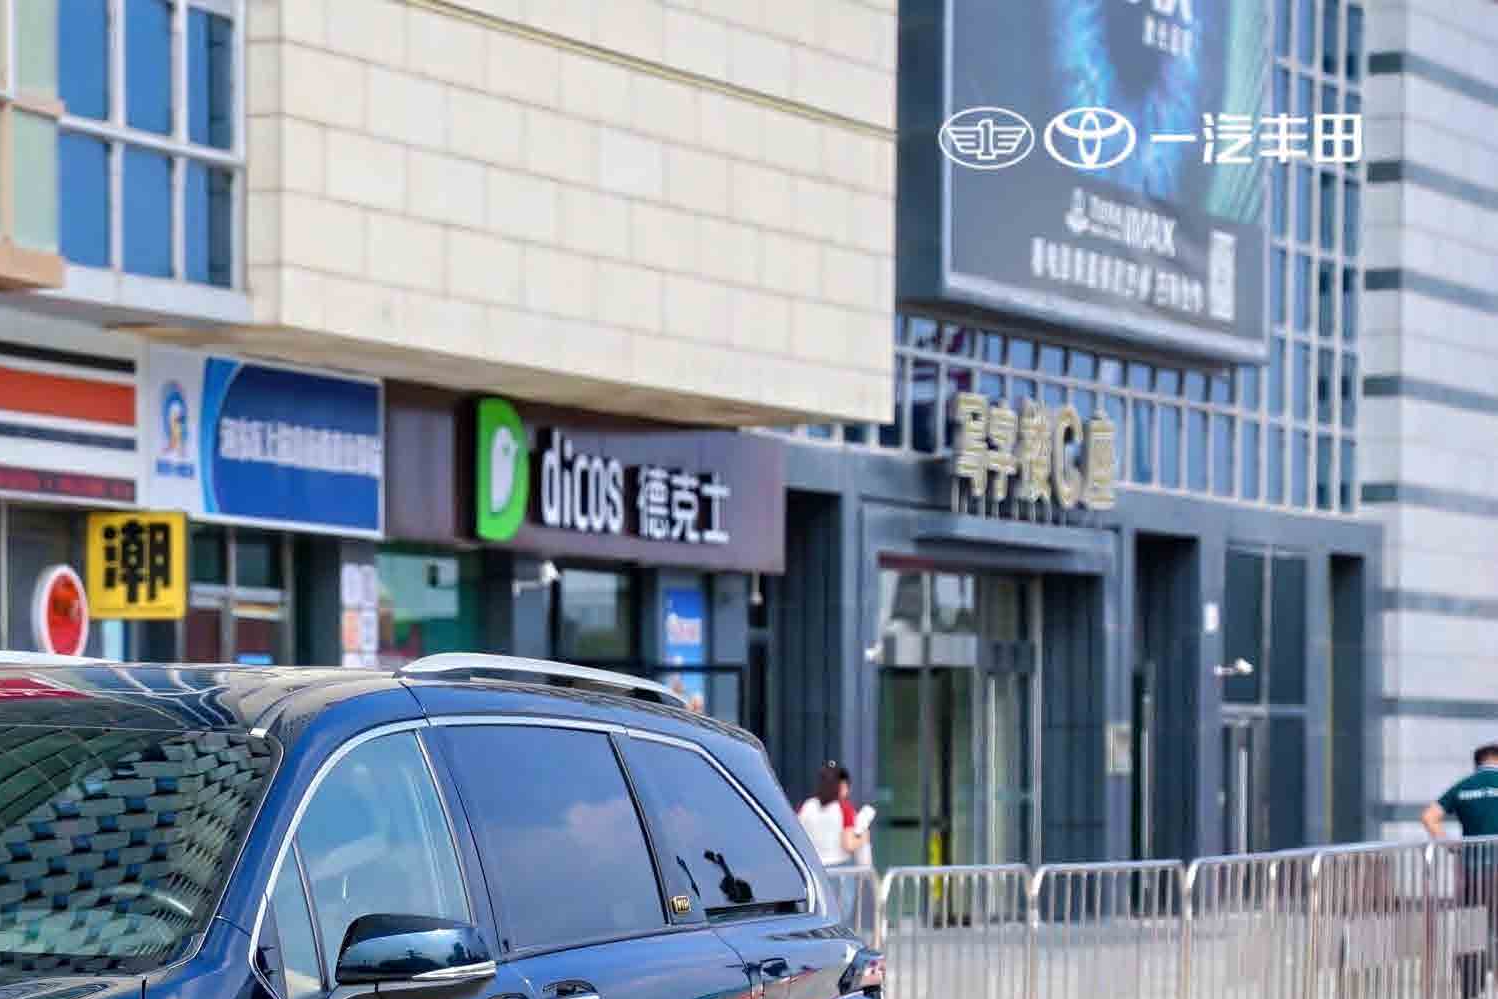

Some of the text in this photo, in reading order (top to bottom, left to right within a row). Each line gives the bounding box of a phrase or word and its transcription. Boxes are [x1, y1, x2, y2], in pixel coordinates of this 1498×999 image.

[540, 427, 731, 543] dicos 德克士
[104, 520, 170, 603] 潮
